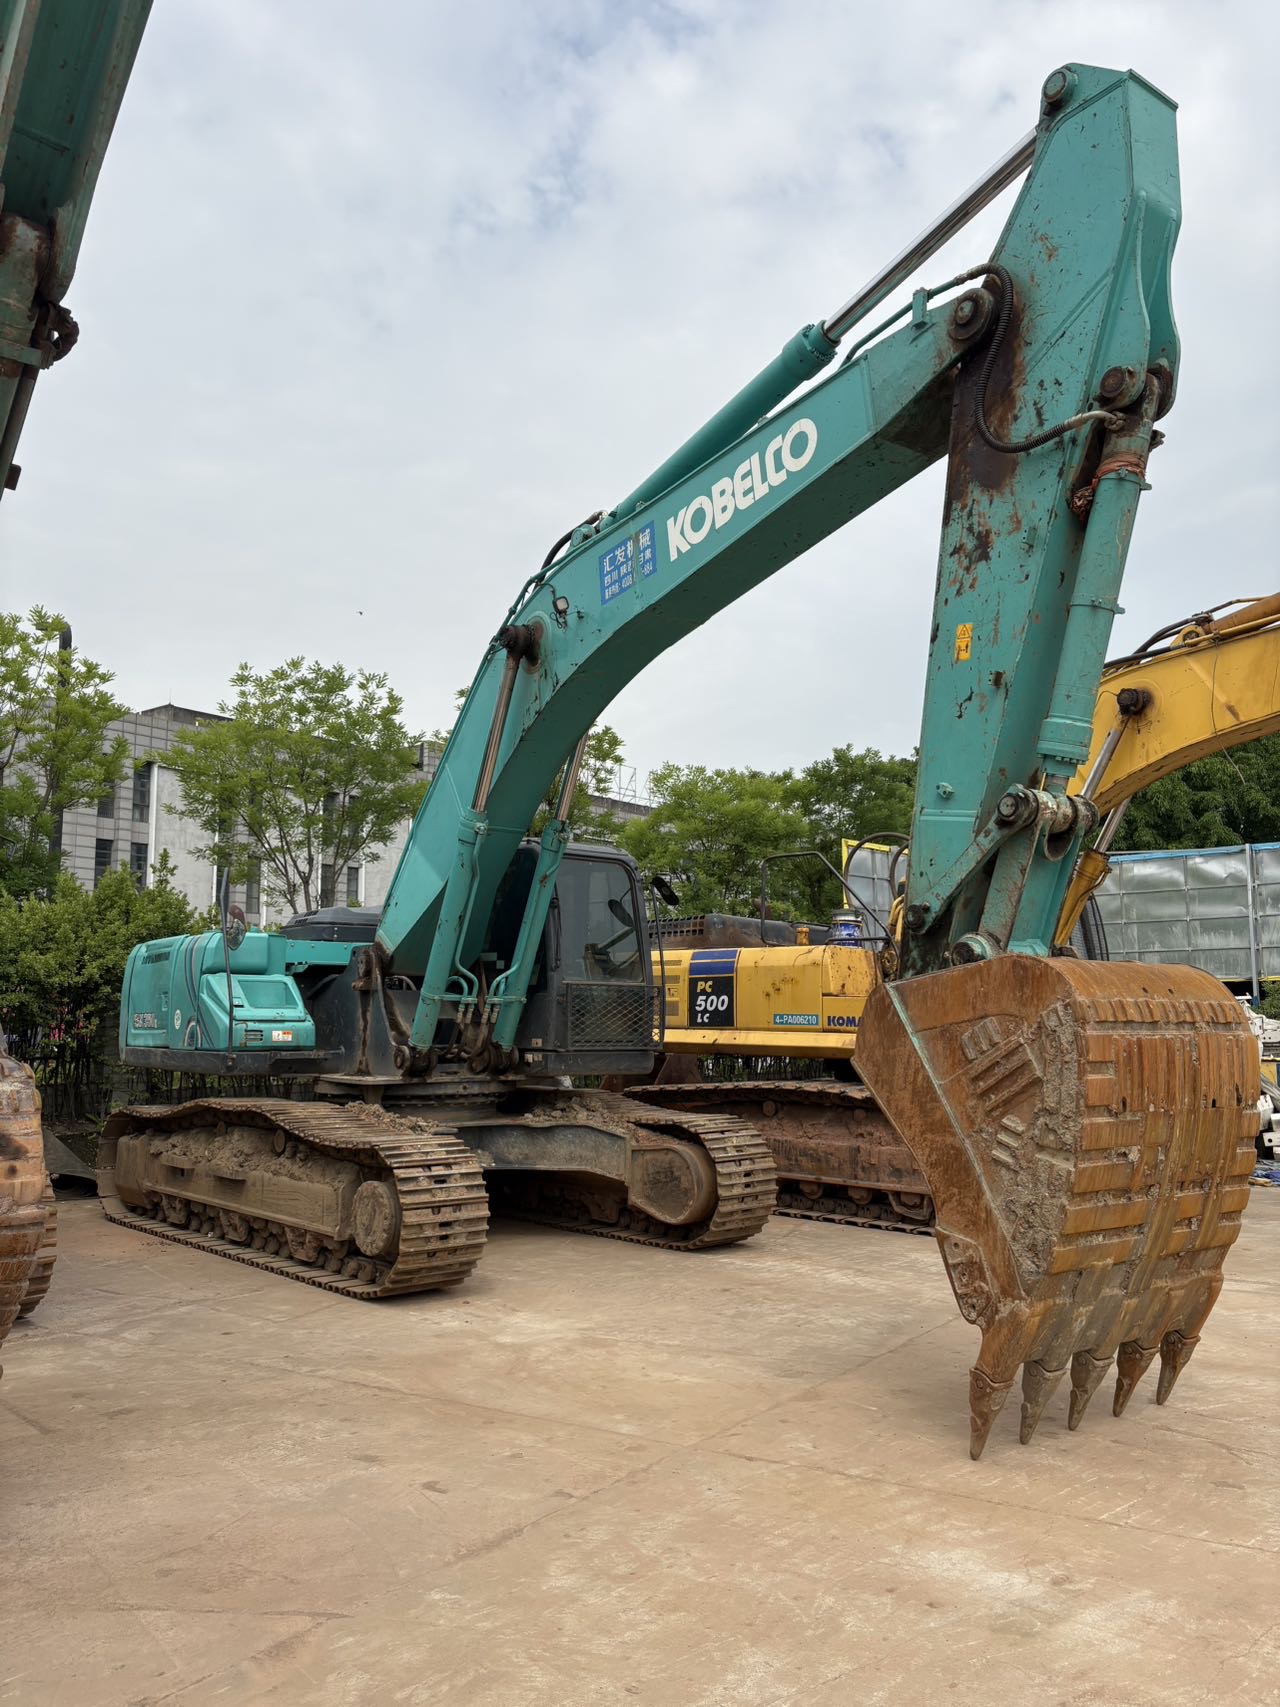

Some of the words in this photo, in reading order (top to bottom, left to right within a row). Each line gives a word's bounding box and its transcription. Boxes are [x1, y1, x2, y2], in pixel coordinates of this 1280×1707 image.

[667, 418, 818, 562] KOBELCO
[696, 980, 713, 993] PC
[695, 995, 729, 1011] 500
[696, 1013, 710, 1023] LC
